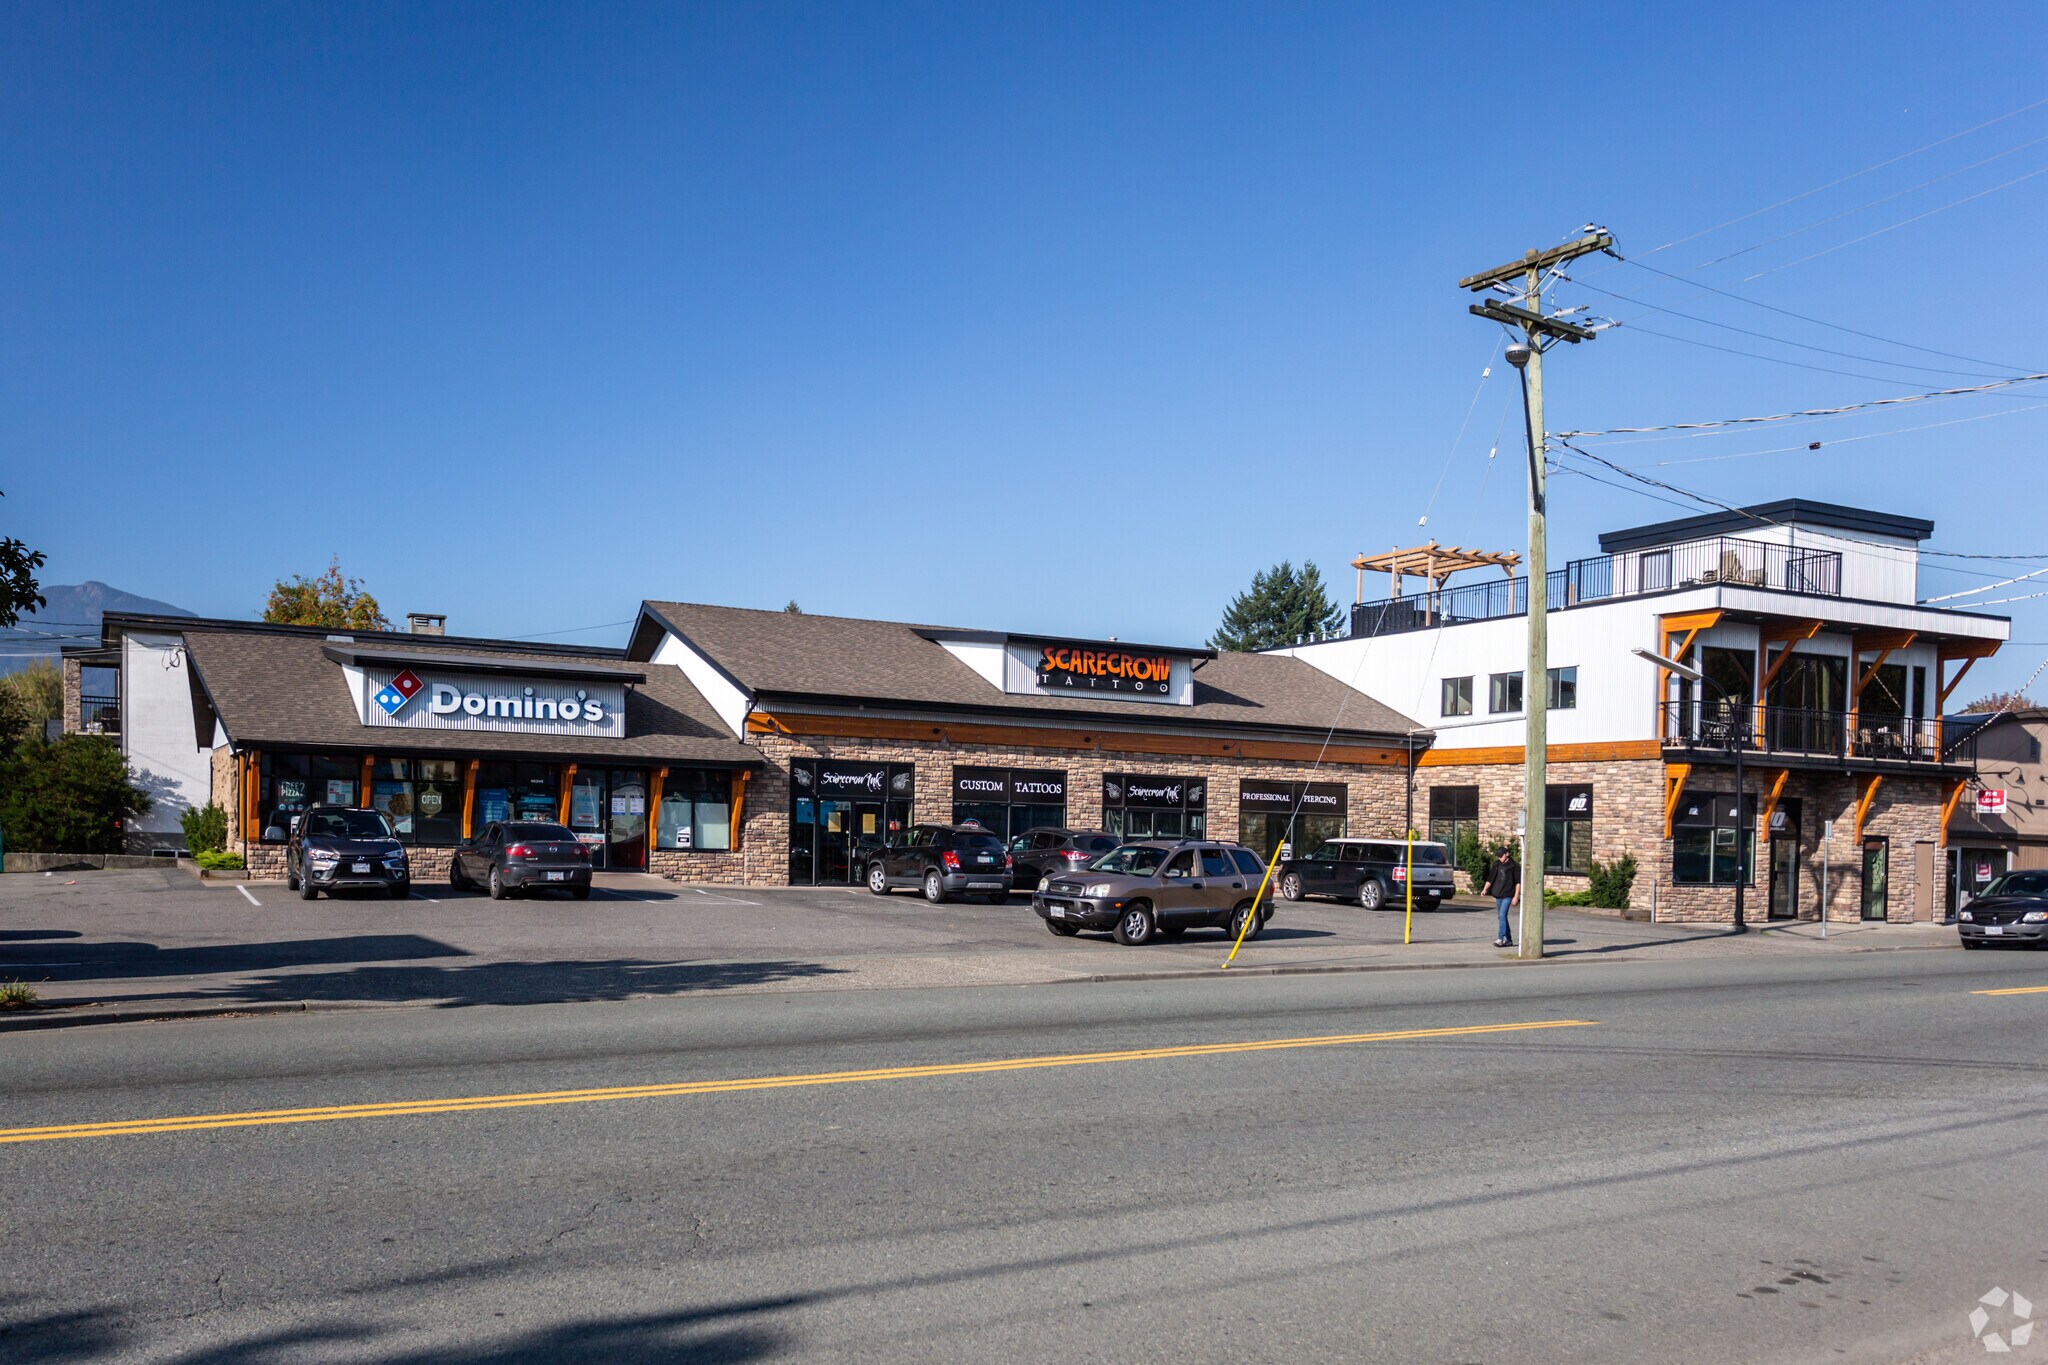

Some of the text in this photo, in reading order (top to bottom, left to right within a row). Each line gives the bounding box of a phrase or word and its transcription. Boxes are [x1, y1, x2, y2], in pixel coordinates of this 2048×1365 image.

[1043, 646, 1171, 682] SCARECROW
[1042, 674, 1169, 693] TATTOO
[432, 683, 604, 722] Domino's
[281, 781, 300, 789] FREE
[960, 779, 1063, 794] CUSTOM TATTOOS
[421, 795, 442, 805] OPEN
[1242, 792, 1337, 805] PROFESSIONAL PIERCING
